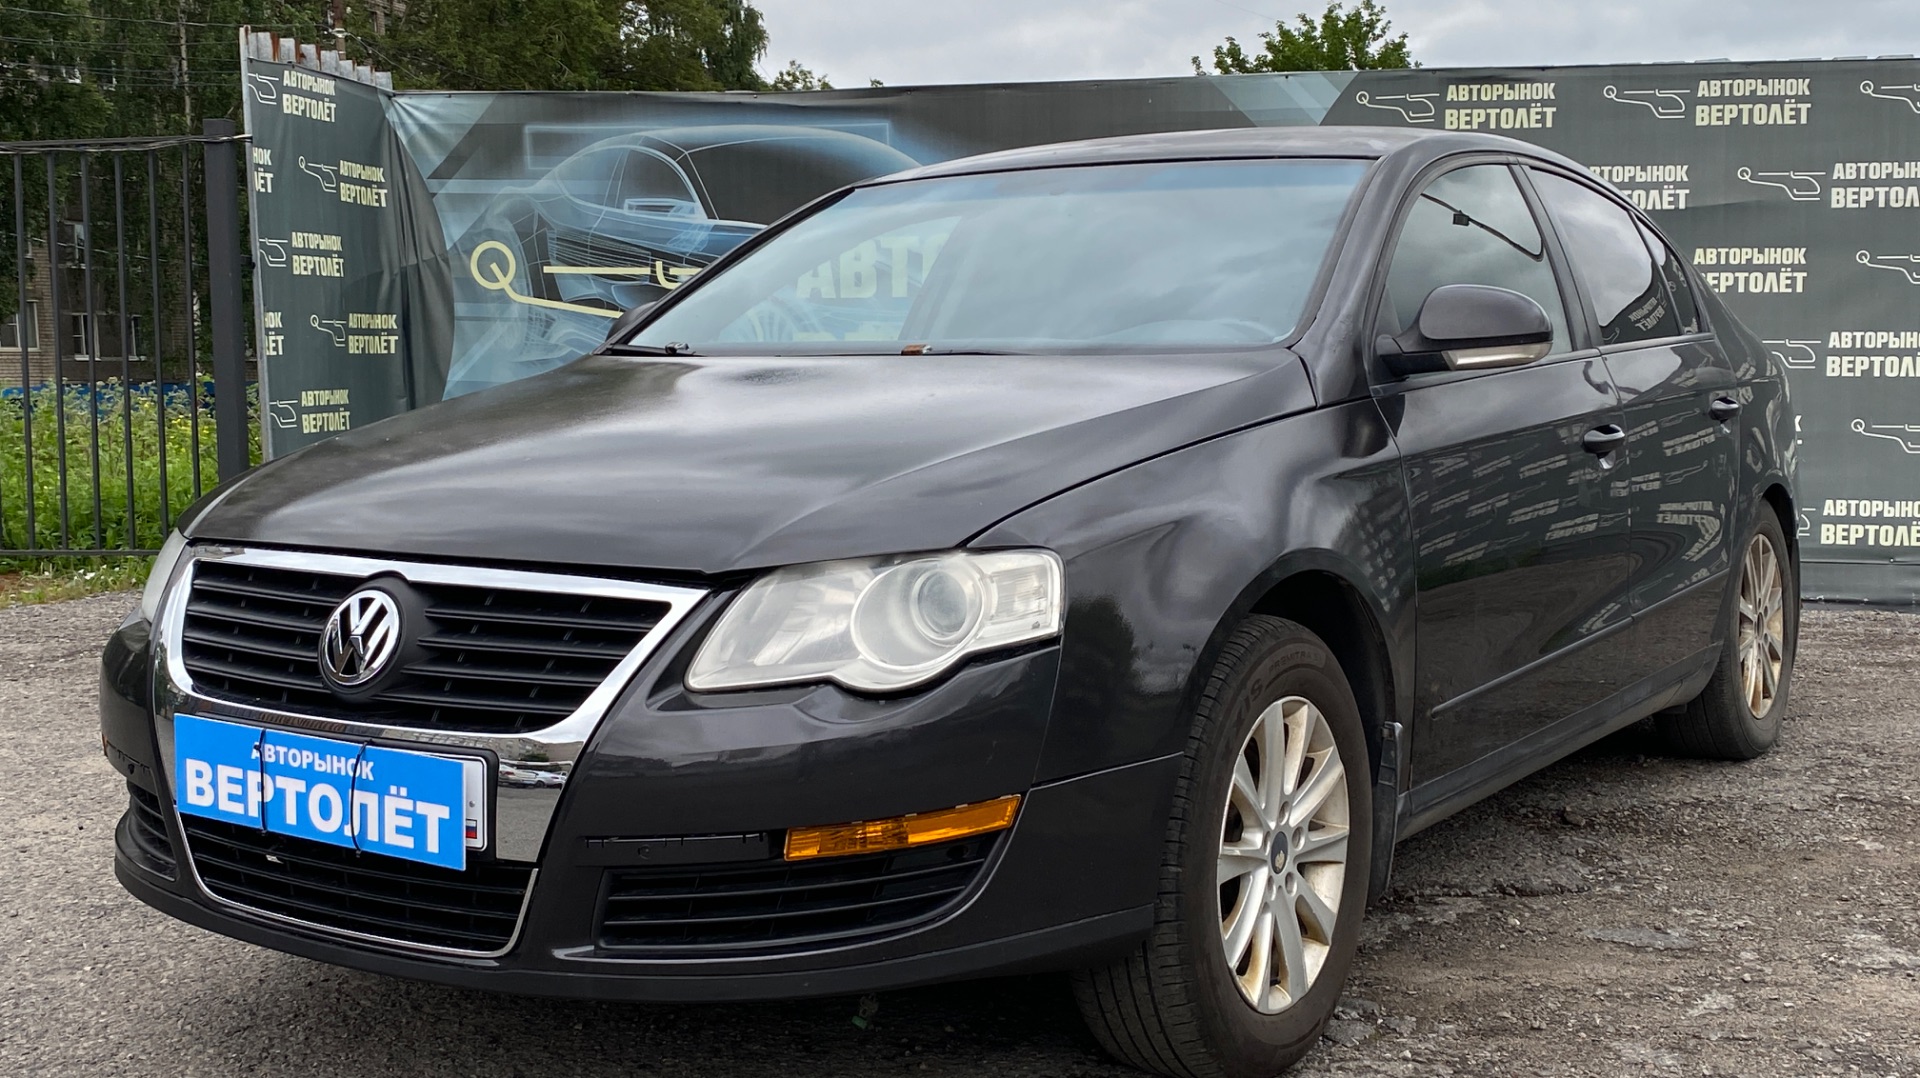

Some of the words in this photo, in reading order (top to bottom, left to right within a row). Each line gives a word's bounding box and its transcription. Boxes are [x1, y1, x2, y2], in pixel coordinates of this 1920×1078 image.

[283, 70, 335, 96] АВТОРЫНОК
[1446, 82, 1556, 102] АВТОРЫНОК
[1697, 78, 1811, 98] АВТОРЫНОК
[283, 93, 336, 122] ВЕРТОЛЁТ
[1445, 103, 1557, 130] ВЕРТОЛЁТ
[1696, 98, 1811, 126] ВЕРТОЛЁТ
[340, 160, 385, 183] АВТОРЫНОК
[1589, 165, 1689, 183] ТОРЫНОК
[1833, 162, 1920, 180] АВТОРЫН
[340, 180, 387, 208] ВЕРТОЛЁТ
[1621, 185, 1690, 210] ОЛЁТ
[1831, 186, 1920, 208] ВЕРТОЛ
[292, 231, 342, 252] АВТОРЫНОК
[292, 253, 344, 277] ВЕРТОЛЁТ
[1693, 248, 1807, 265] АВТОРЫНОК
[1700, 267, 1807, 293] ЕРТОЛЁТ
[349, 312, 397, 329] АВТОРЫНОК
[348, 331, 398, 354] ВЕРТОЛЁТ
[1828, 331, 1920, 348] АВТОРЫН
[1826, 352, 1920, 377] ВЕРТОЛ
[301, 389, 349, 407] АВТОРЫНОК
[302, 408, 350, 433] ВЕРТОЛЁТ
[1823, 499, 1920, 517] АВТОРЫНО
[1820, 521, 1920, 547] ВЕРТОЛЁ
[251, 742, 374, 781] АВТОРЫНОК
[186, 758, 450, 854] ВЕРТОЛЁТ
